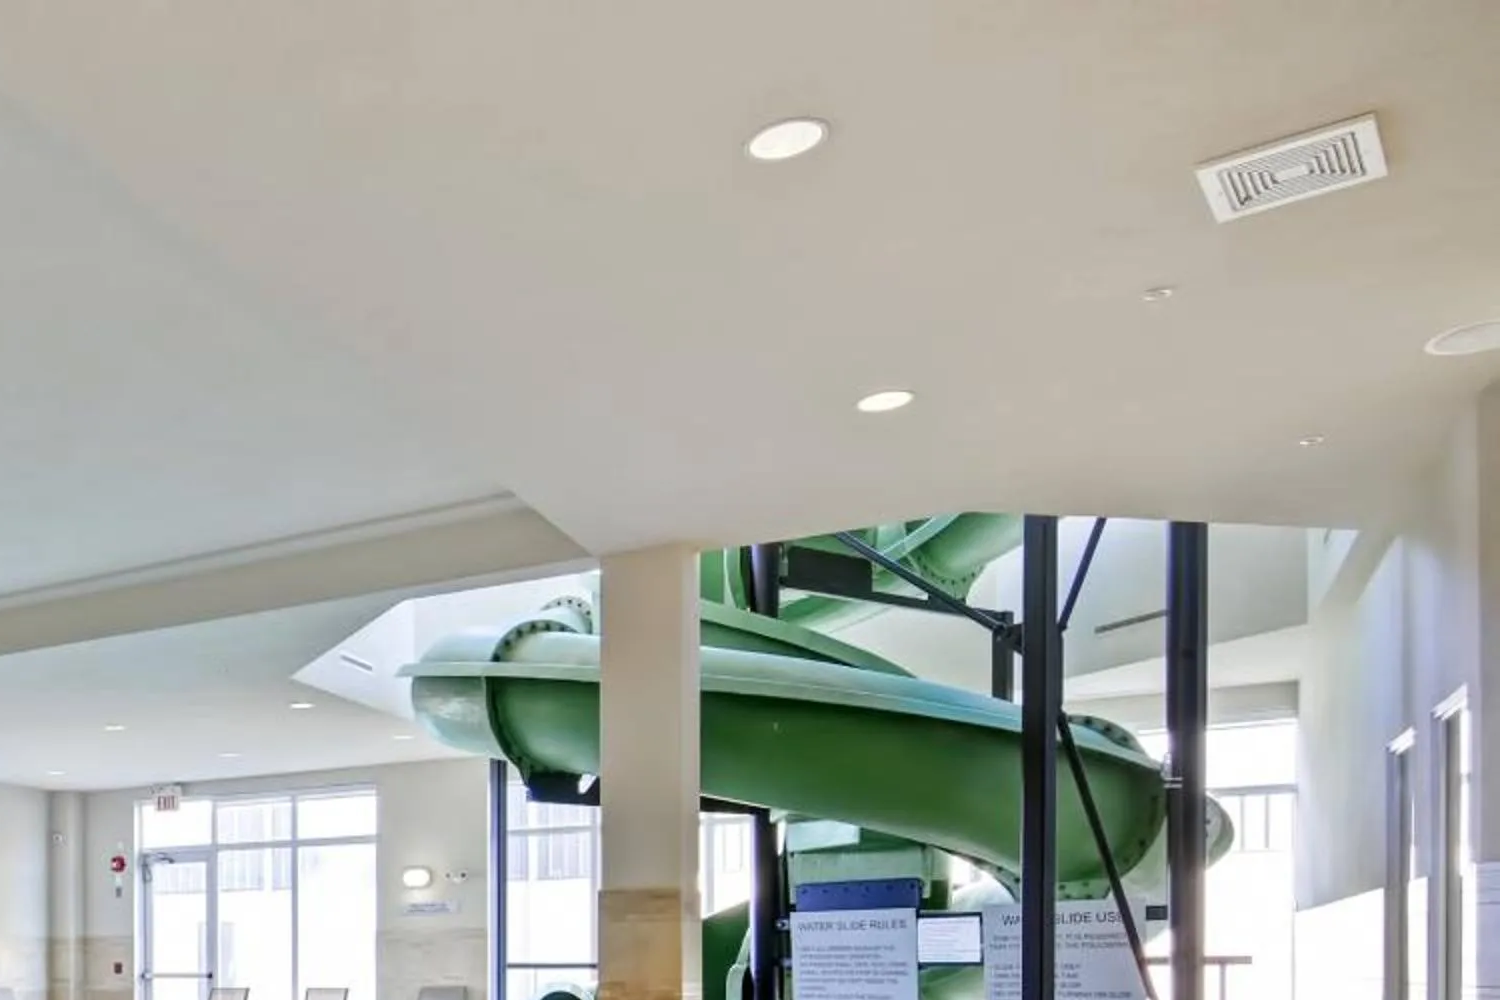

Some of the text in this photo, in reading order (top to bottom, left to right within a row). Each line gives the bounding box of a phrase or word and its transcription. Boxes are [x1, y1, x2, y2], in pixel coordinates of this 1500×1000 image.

[798, 918, 907, 932] WATER SLIDE RULES
[1054, 911, 1092, 925] SLIDE
